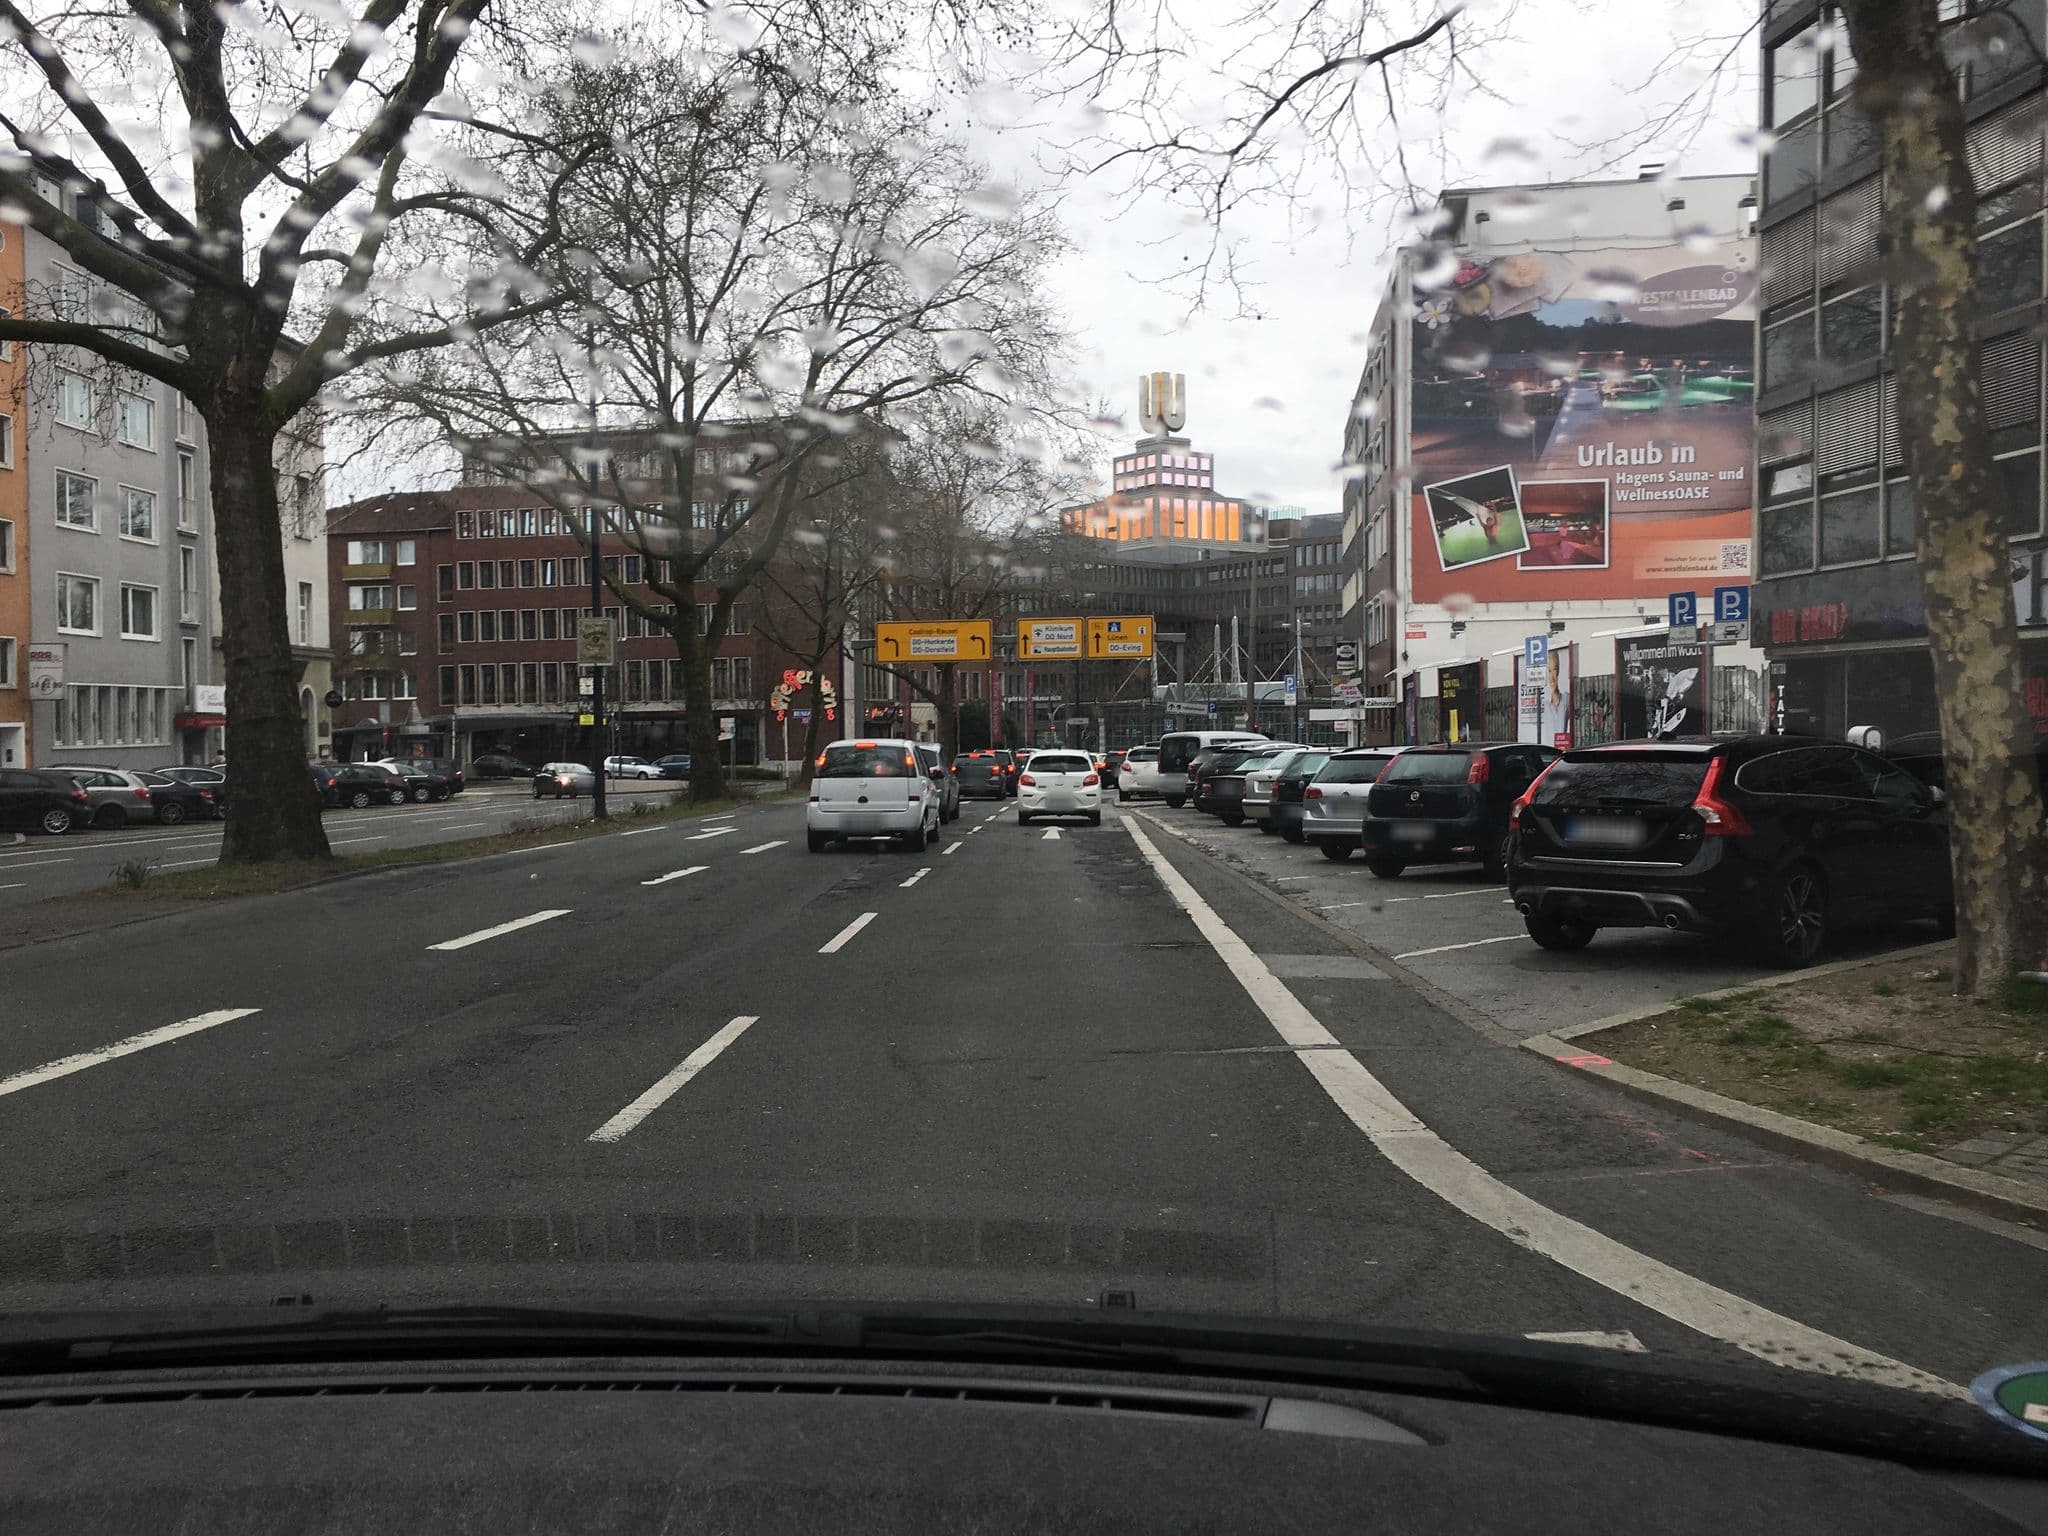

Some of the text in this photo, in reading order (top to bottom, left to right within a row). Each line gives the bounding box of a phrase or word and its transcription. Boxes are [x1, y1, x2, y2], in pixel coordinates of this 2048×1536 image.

[1577, 441, 1695, 467] Urlaub in
[1616, 467, 1744, 487] Hagens Sauna- und
[1616, 486, 1710, 502] WellnessOASE
[1674, 596, 1690, 625] P
[1722, 591, 1740, 619] P
[1109, 644, 1141, 652] DO-Eving
[1530, 639, 1543, 665] P
